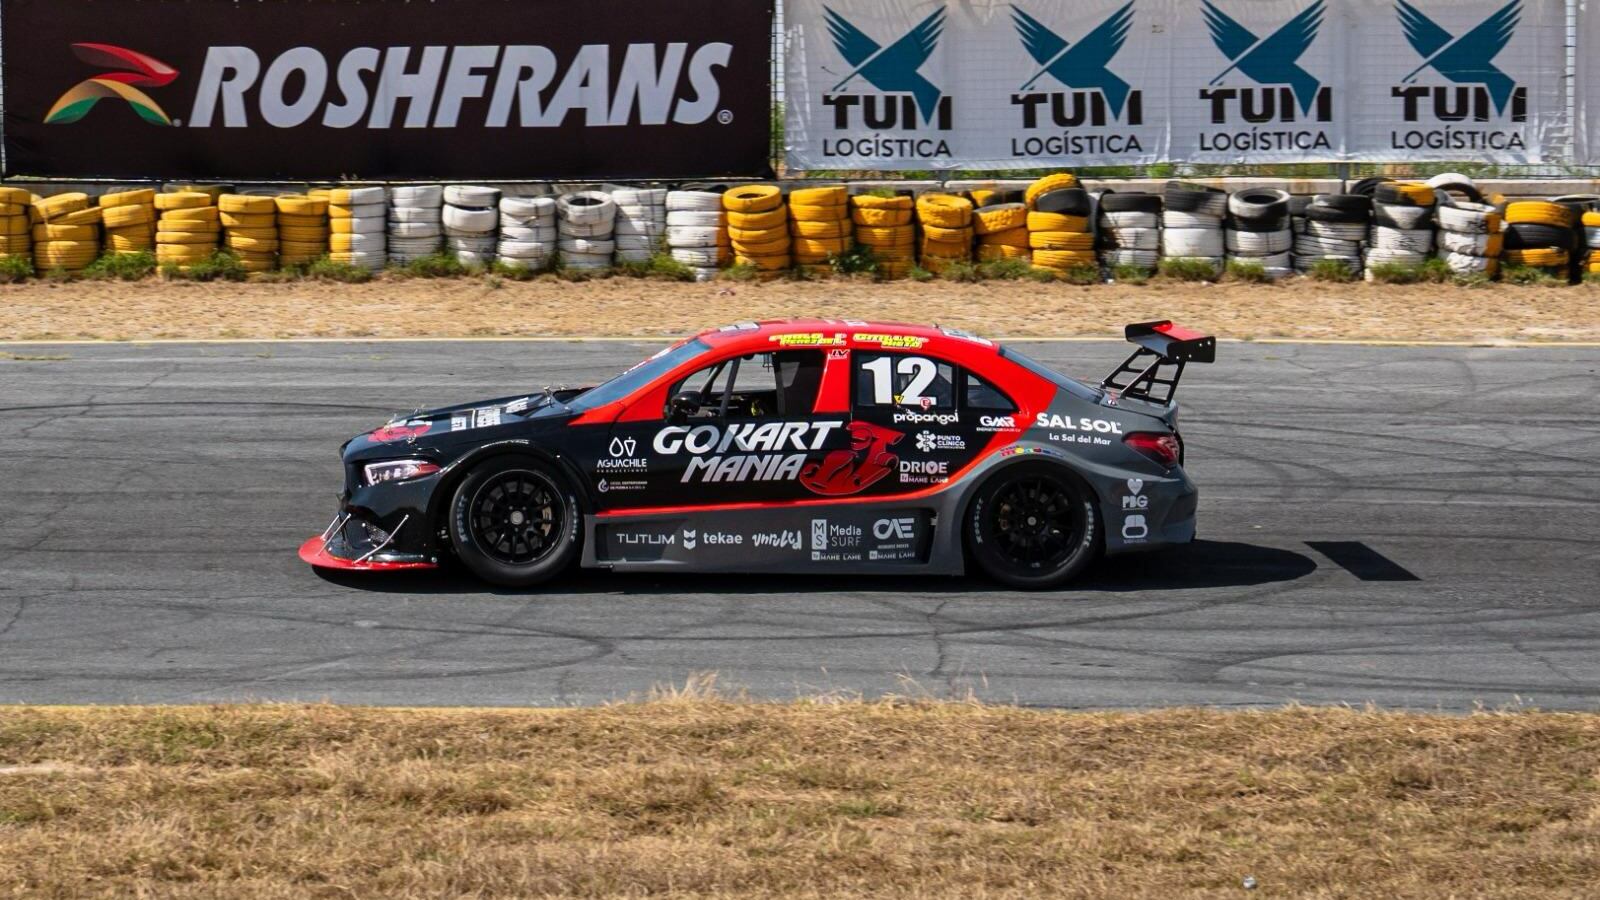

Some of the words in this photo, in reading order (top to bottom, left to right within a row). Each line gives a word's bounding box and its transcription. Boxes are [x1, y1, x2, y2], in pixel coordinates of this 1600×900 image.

[188, 42, 733, 128] ROSHFRANS
[822, 94, 953, 130] TUM
[1010, 90, 1143, 128] TUM
[1199, 86, 1332, 124] TUM
[1391, 86, 1528, 122] TUM
[823, 133, 952, 157] LOGÍSTICA
[1012, 131, 1143, 156] LOGÍSTICA
[1200, 126, 1331, 151] LOGÍSTICA
[1392, 125, 1526, 150] LOGÍSTICA
[862, 357, 937, 405] 12
[1036, 412, 1077, 429] SAL
[1080, 418, 1122, 434] SOL
[653, 421, 843, 455] GOKART
[1049, 432, 1060, 441] La
[1062, 433, 1076, 442] Sal
[1077, 435, 1091, 443] del
[1093, 437, 1111, 445] Mar
[597, 459, 647, 468] AGUACHILE
[680, 453, 808, 483] MANIA
[616, 534, 675, 544] TUTUM
[703, 532, 743, 544] tekae
[830, 525, 862, 536] Media
[831, 536, 862, 547] SURF
